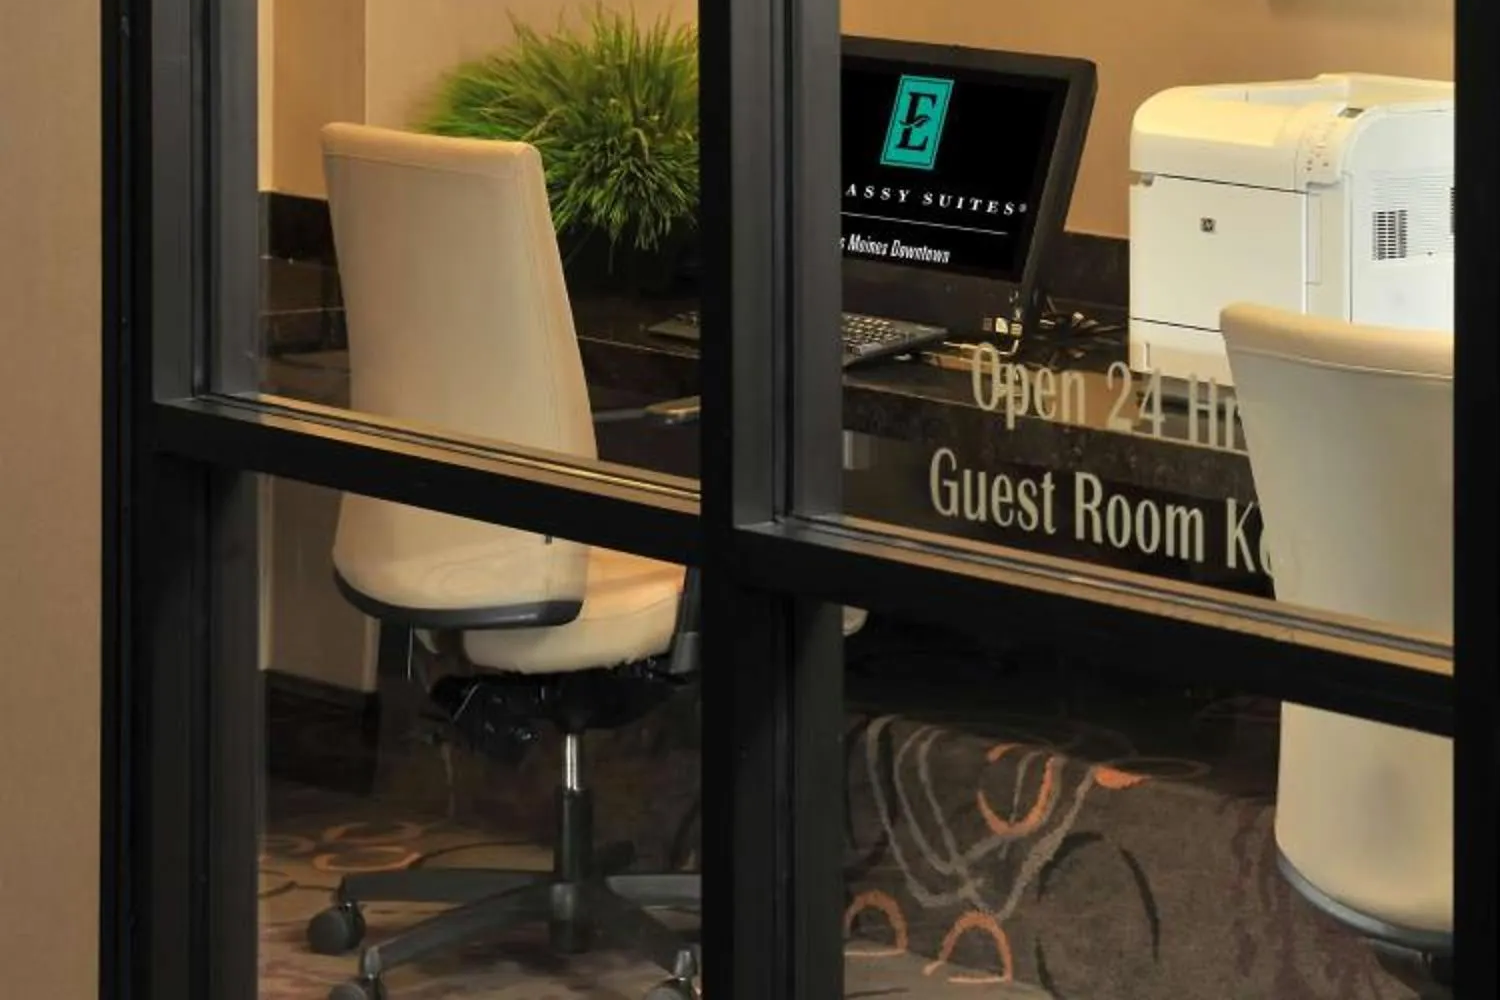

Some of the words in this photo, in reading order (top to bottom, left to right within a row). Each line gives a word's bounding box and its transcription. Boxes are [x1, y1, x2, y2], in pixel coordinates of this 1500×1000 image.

[847, 233, 889, 256] Moines
[890, 239, 951, 264] Downtown
[972, 342, 1086, 430] Open
[1107, 361, 1165, 438] 24
[930, 448, 1057, 535] Guest
[1074, 471, 1205, 564] Room
